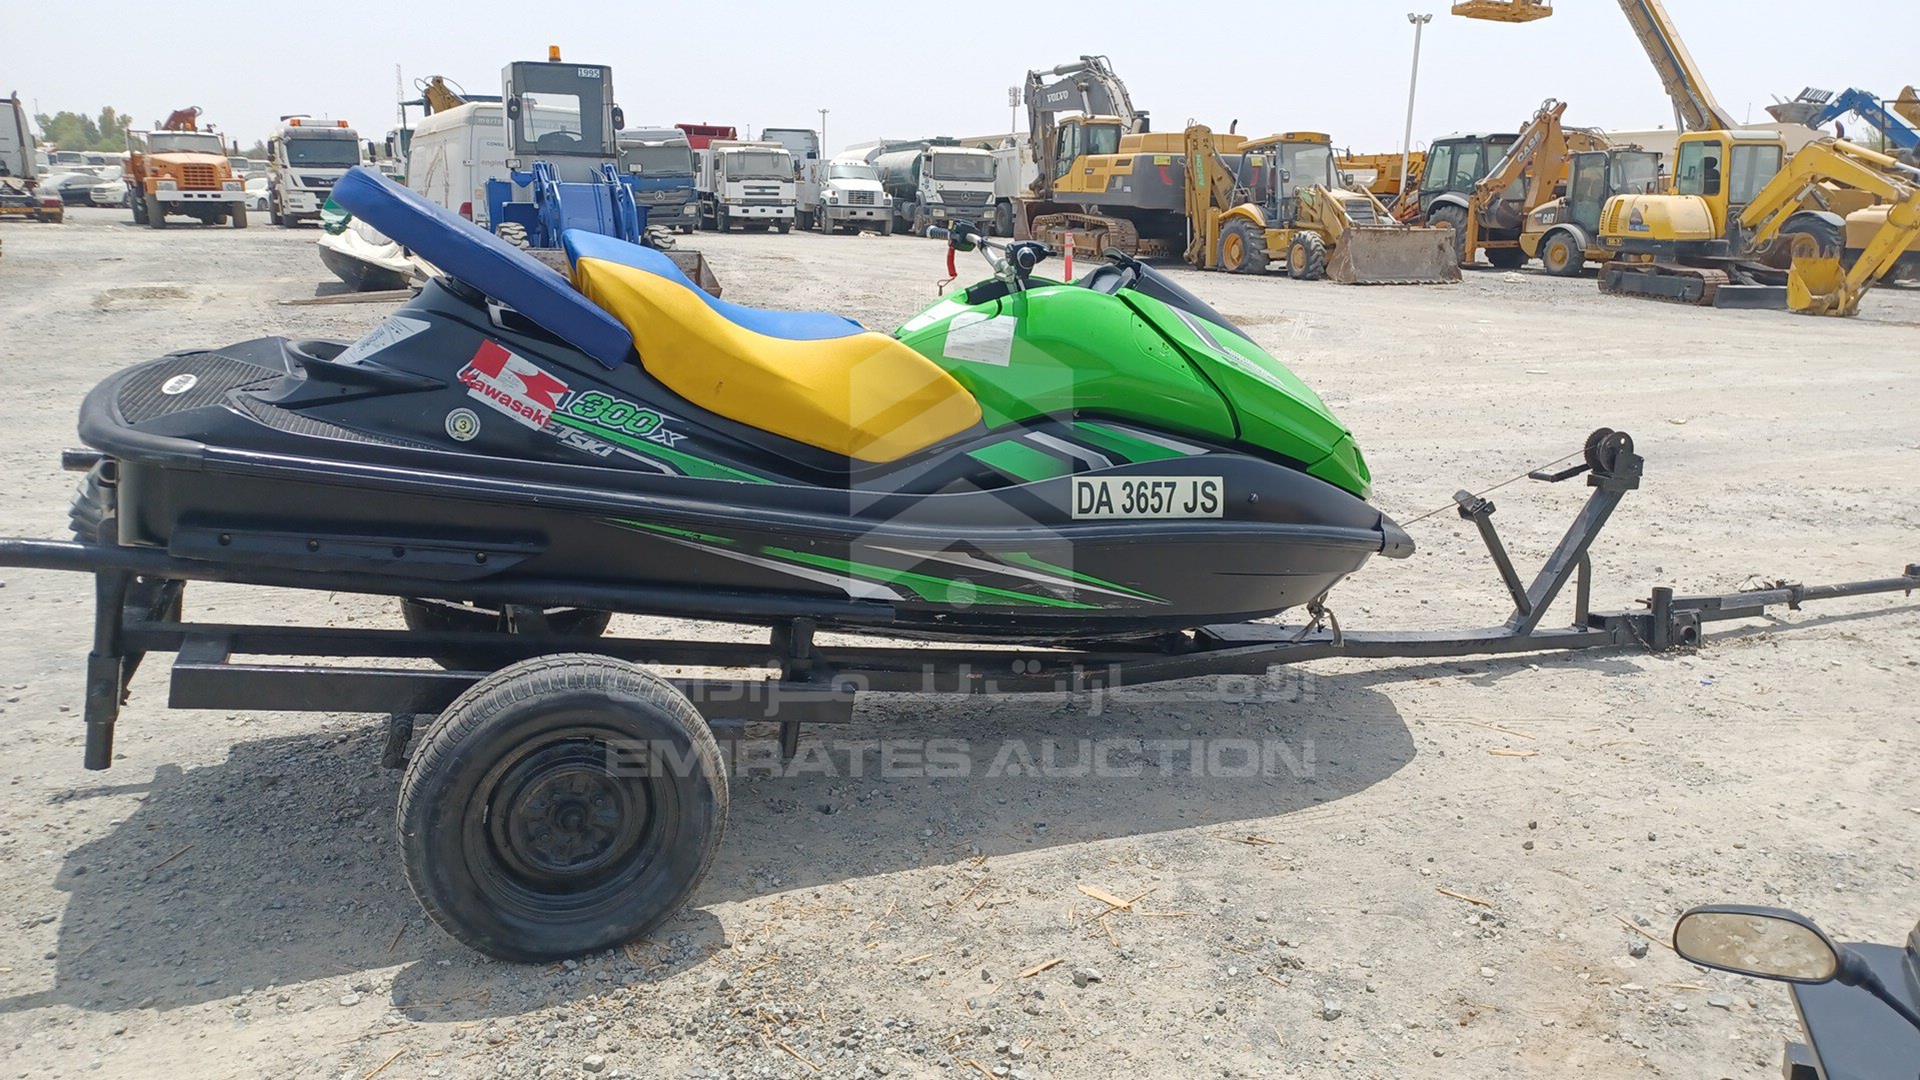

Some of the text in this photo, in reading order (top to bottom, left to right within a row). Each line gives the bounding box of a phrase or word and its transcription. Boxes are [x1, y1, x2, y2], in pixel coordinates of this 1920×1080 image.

[579, 68, 600, 78] 1995
[1542, 213, 1555, 224] CAT
[1078, 481, 1218, 514] DA 3657 JS
